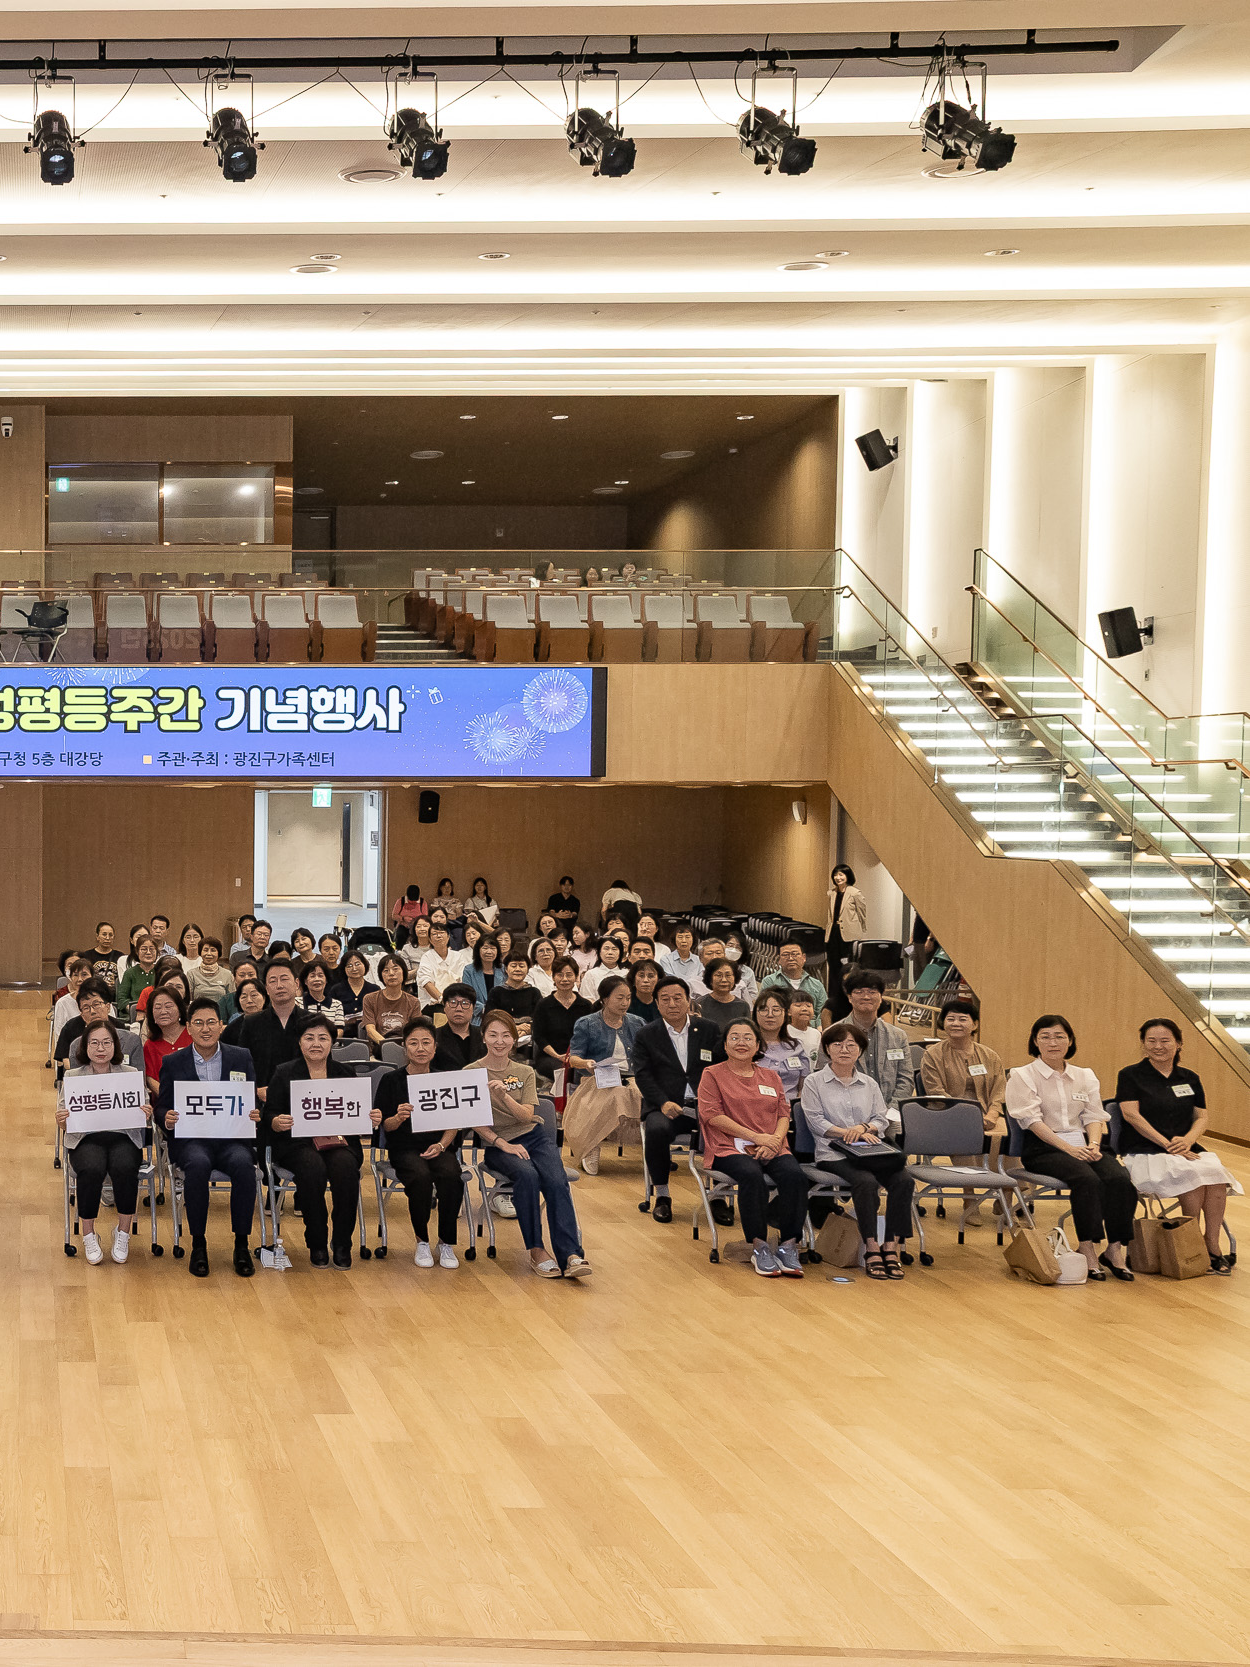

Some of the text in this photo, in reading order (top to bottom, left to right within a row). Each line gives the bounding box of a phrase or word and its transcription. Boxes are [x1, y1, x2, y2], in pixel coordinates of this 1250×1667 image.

[213, 685, 406, 733] 기념행사
[32, 751, 56, 767] 5층
[59, 751, 104, 767] 대강당
[232, 751, 335, 767] 광진구가족센터
[68, 1090, 141, 1112] 성평등사회
[185, 1095, 245, 1116] 모두가
[301, 1096, 361, 1120] 행복한
[418, 1085, 481, 1112] 광진구
